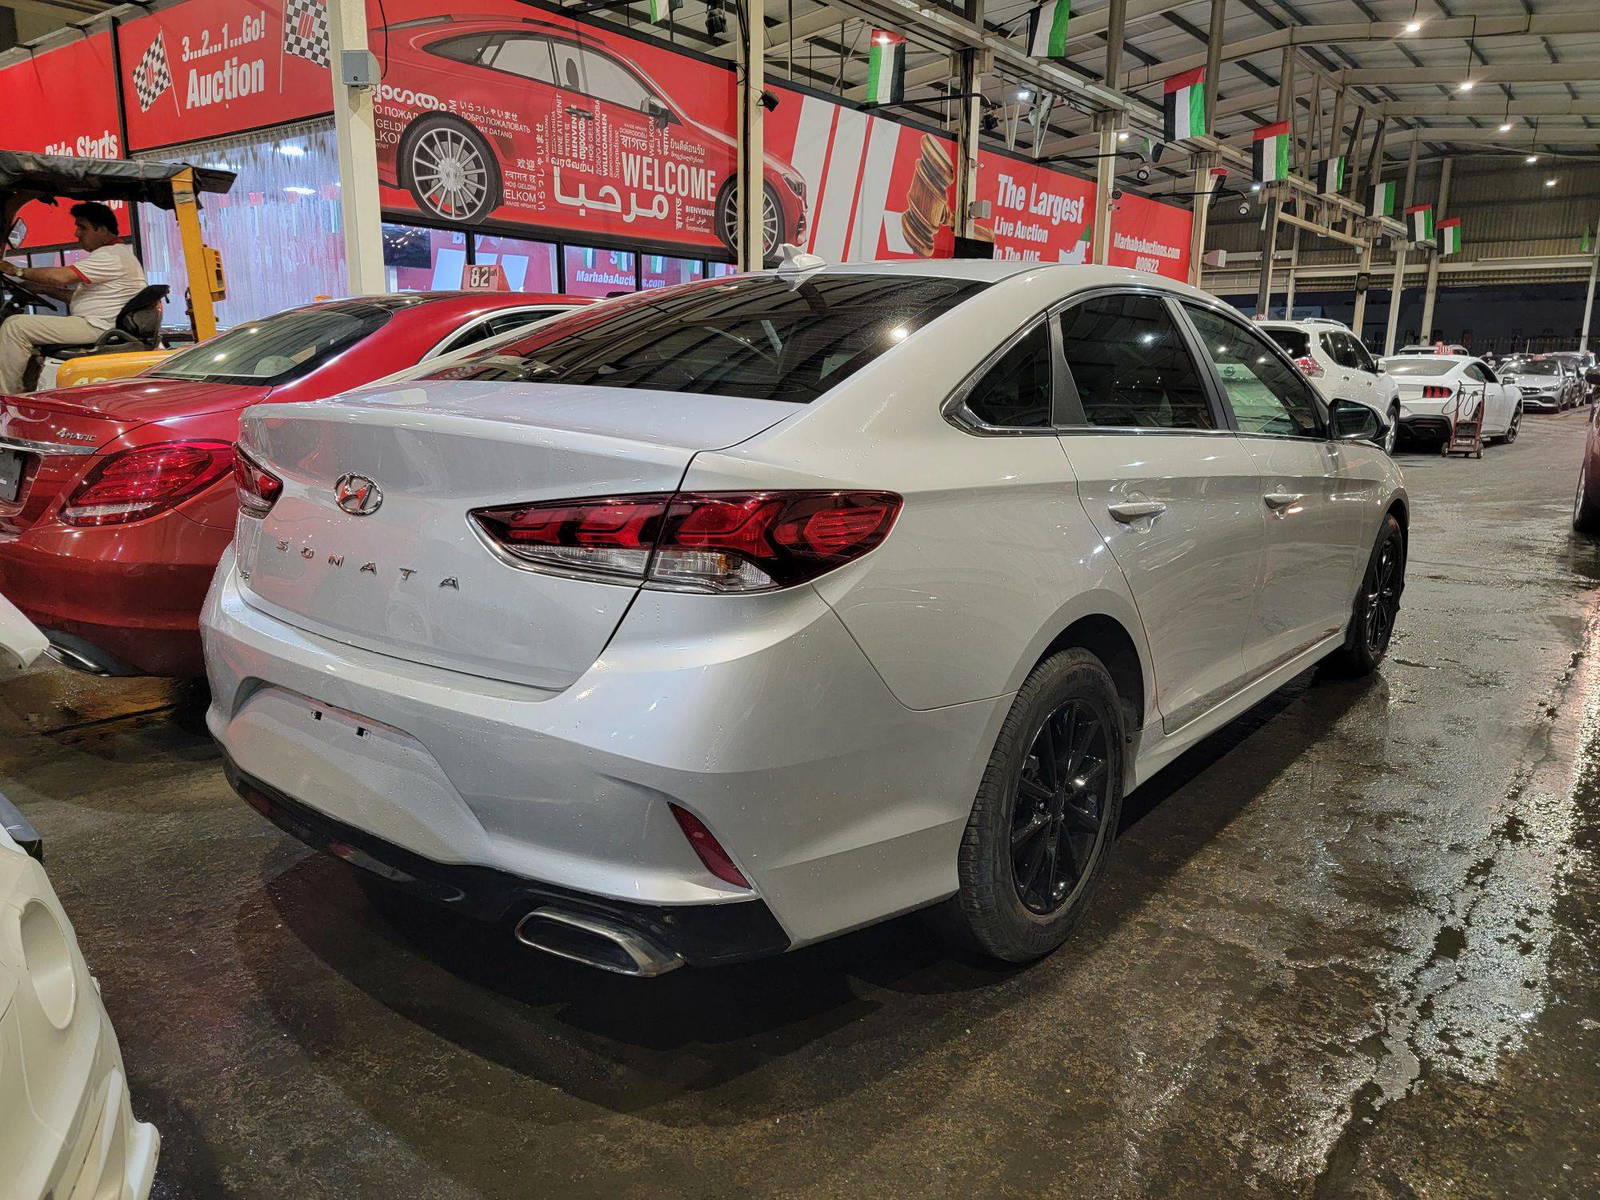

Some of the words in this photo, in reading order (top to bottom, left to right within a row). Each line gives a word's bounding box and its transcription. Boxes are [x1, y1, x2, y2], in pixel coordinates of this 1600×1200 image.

[186, 57, 264, 109] Auction
[76, 130, 118, 159] Starts
[621, 151, 717, 203] WELCOME
[553, 166, 669, 223] مرحبا
[998, 174, 1026, 212] The
[1029, 183, 1084, 225] Largest
[994, 215, 1014, 236] Live
[1015, 223, 1048, 243] Auction
[1004, 248, 1021, 262] The
[1114, 232, 1180, 259] MarhabaAuctions.com
[469, 266, 489, 288] 82
[576, 269, 666, 289] MarhabaAuctis.com
[276, 541, 459, 591] SONATA
